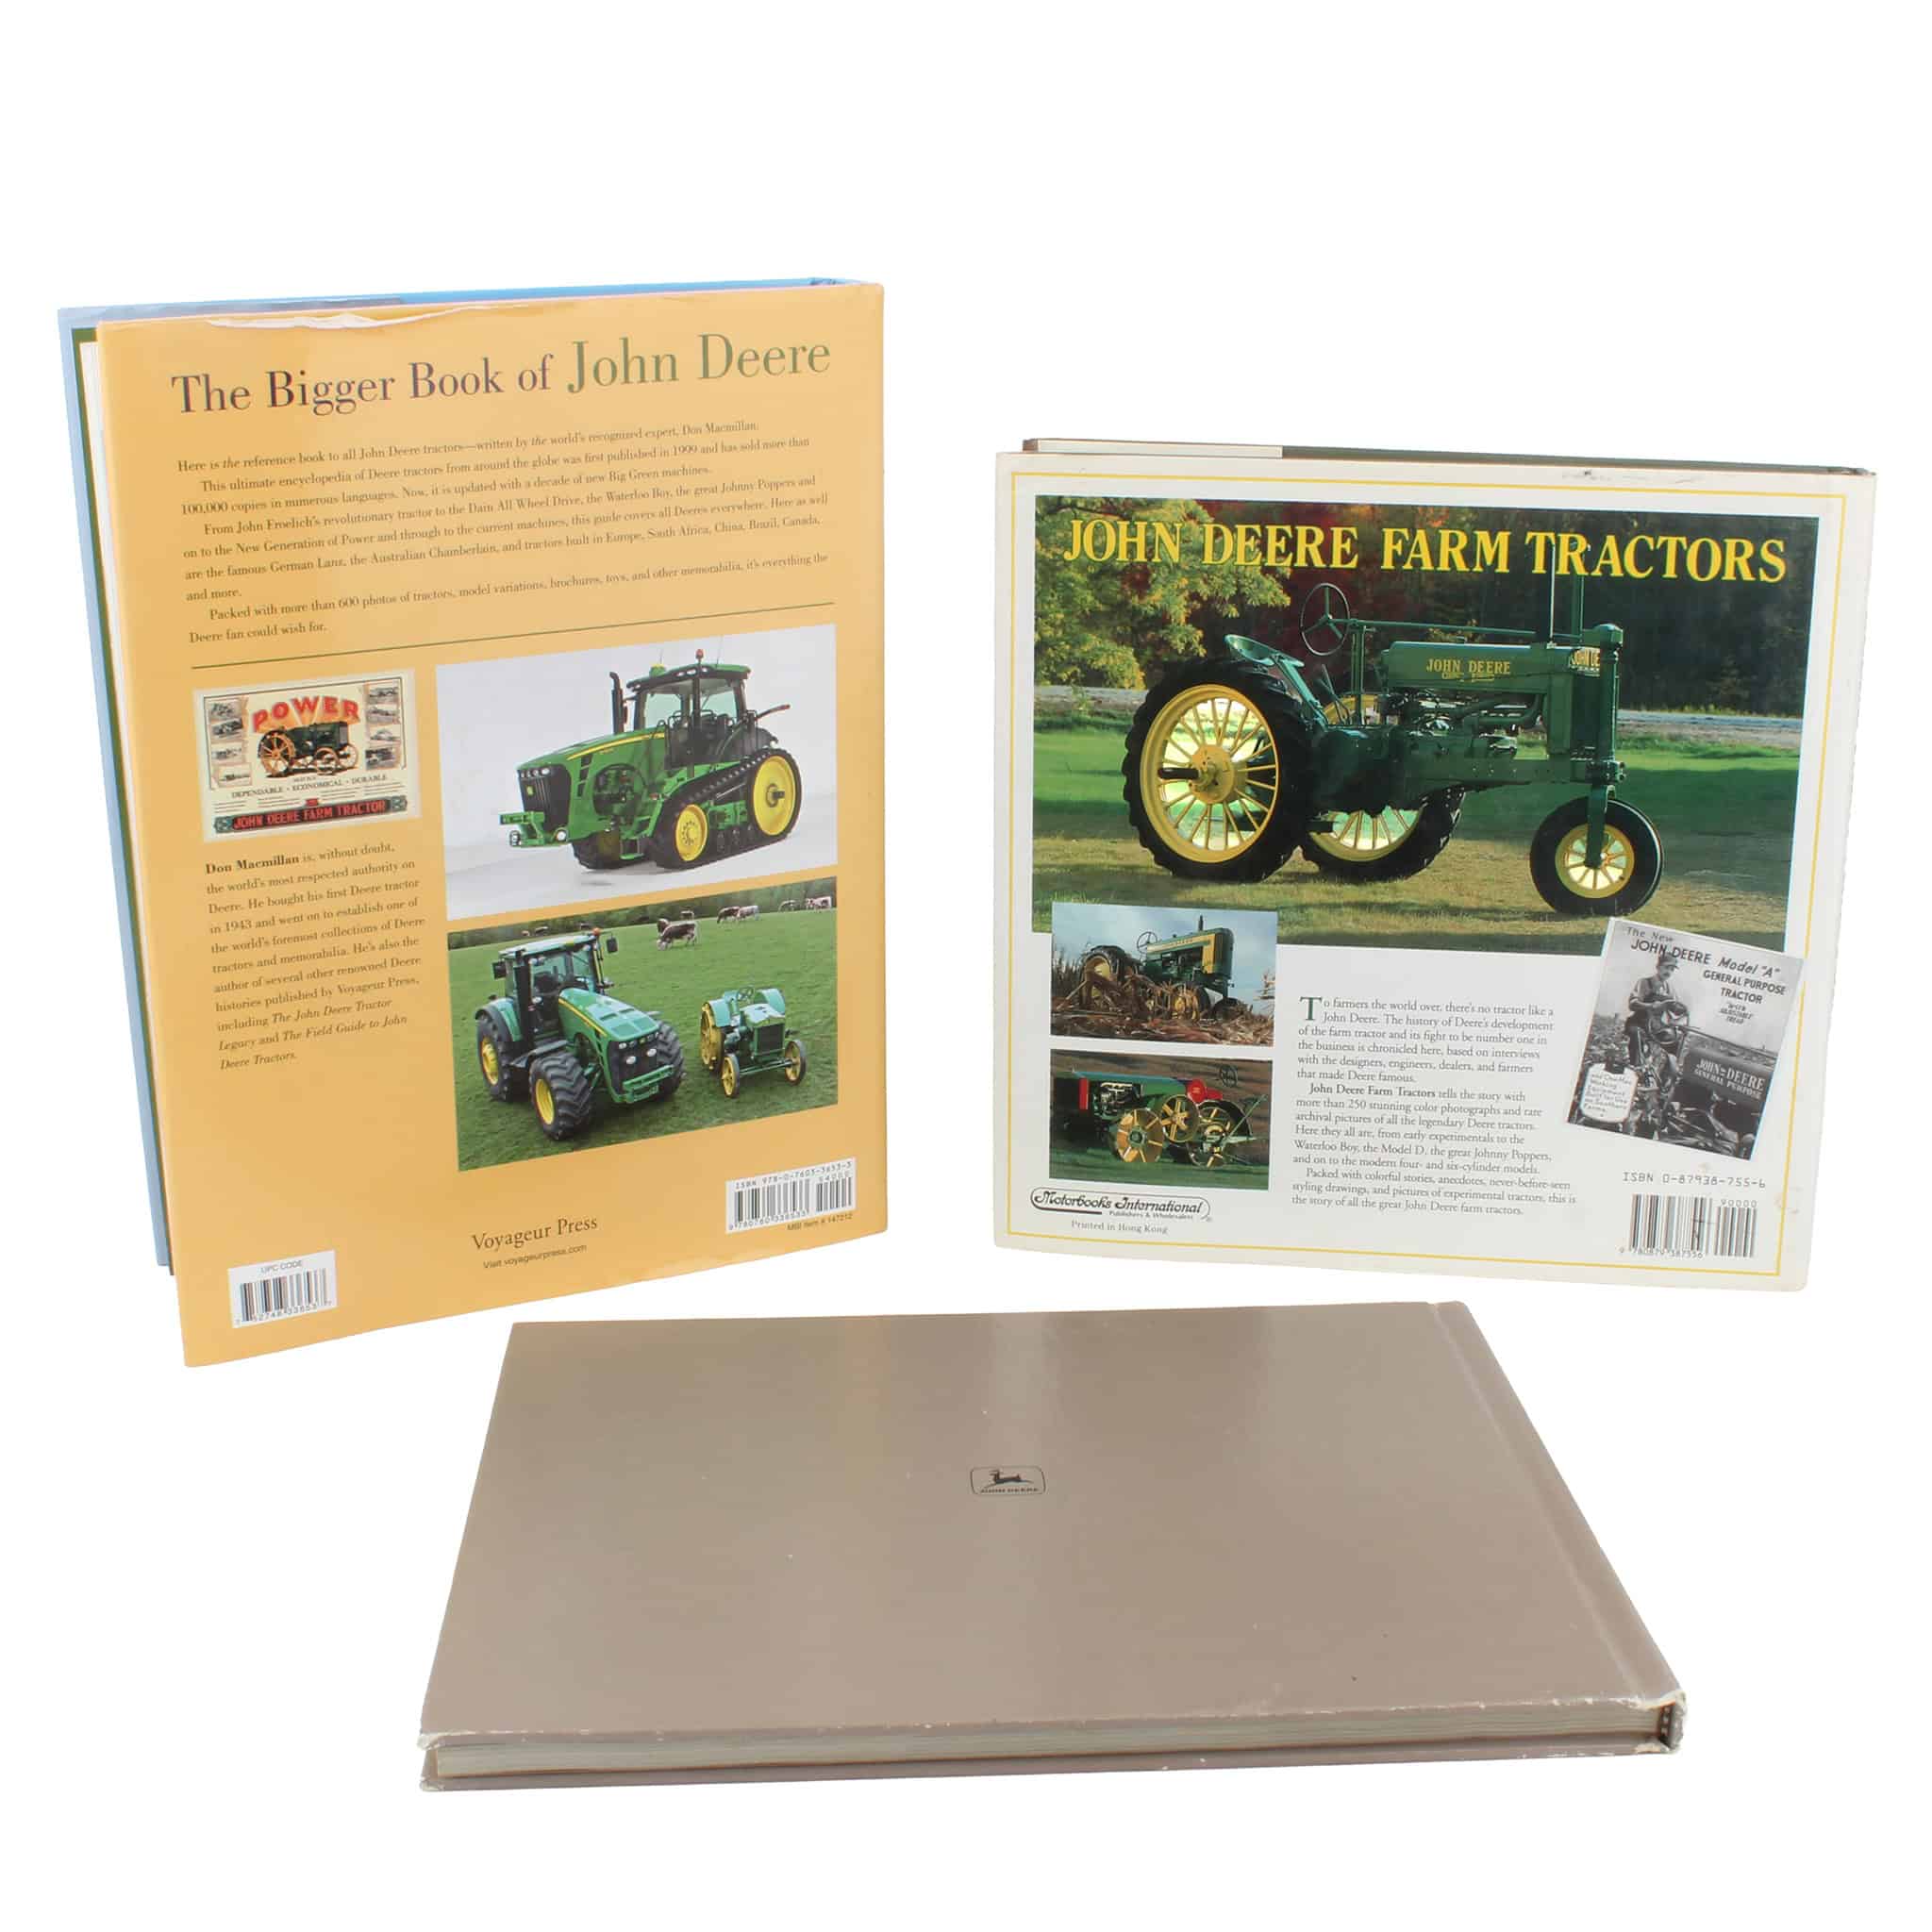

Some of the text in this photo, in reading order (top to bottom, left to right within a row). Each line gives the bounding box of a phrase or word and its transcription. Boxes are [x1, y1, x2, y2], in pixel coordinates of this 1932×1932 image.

[172, 332, 831, 416] The Bigger Book of John Deere
[177, 460, 206, 472] Here
[209, 459, 219, 470] is
[222, 458, 240, 469] the
[242, 454, 295, 467] reference
[298, 452, 325, 463] book
[325, 451, 339, 461] to
[341, 450, 357, 460] all
[358, 448, 388, 461] John
[388, 445, 421, 457] Deere
[515, 438, 527, 451] by
[530, 437, 547, 447] the
[550, 434, 585, 445] world's
[681, 425, 702, 437] Don
[1062, 519, 1788, 584] JOHN DEERE FARM TRACTORS
[186, 591, 208, 601] and
[190, 631, 223, 643] Deere
[225, 629, 244, 640] fan
[246, 626, 277, 639] could
[280, 625, 306, 636] wish
[1426, 658, 1511, 675] JOHN DEERE
[253, 695, 360, 733] POWER
[231, 788, 283, 798] DEPENDABLE
[352, 774, 388, 784] DURABLE
[233, 800, 386, 829] JOHN DEERE FARM TRACTOR
[206, 861, 232, 874] Don
[236, 853, 299, 871] Macmillan
[319, 846, 358, 860] without
[247, 897, 264, 909] He
[266, 892, 304, 909] bought
[306, 890, 324, 902] his
[325, 887, 346, 900] first
[349, 883, 382, 897] Deere
[384, 878, 419, 892] tractor
[1626, 926, 1675, 942] The New
[1631, 940, 1667, 956] JOHN
[1674, 946, 1711, 965] DEERE
[1718, 957, 1759, 976] Model
[1703, 970, 1786, 996] GENERAL PURPOSE
[1720, 987, 1763, 1004] TRACTOR
[218, 997, 391, 1034] including The John Deere Tractor
[1300, 996, 1330, 1021] To
[1332, 999, 1369, 1009] farmers
[1371, 1000, 1387, 1009] the
[1390, 1001, 1417, 1010] world
[1445, 1003, 1474, 1012] there's
[1493, 1004, 1524, 1014] tractor
[1527, 1005, 1545, 1015] like
[219, 1015, 407, 1052] Legacy and The Field Guide to John
[1323, 1013, 1348, 1025] John
[1383, 1015, 1403, 1025] The
[1405, 1016, 1440, 1029] history
[1441, 1018, 1454, 1027] of
[1455, 1018, 1489, 1028] Deere's
[1491, 1020, 1552, 1033] development
[220, 1056, 249, 1070] Deere
[1297, 1069, 1316, 1078] that
[1318, 1070, 1344, 1080] made
[1347, 1071, 1376, 1081] Deere
[1727, 1067, 1765, 1091] DEERE
[1309, 1084, 1524, 1103] John Deere Farm Tractors tells the story with
[736, 1180, 757, 1190] ISBN
[1623, 1172, 1766, 1189] ISBN 0-87938-755-6
[1035, 1191, 1203, 1214] Motorbooks International
[1291, 1194, 1307, 1205] the
[1309, 1195, 1333, 1208] story
[1335, 1196, 1346, 1207] of
[1347, 1197, 1358, 1207] all
[1361, 1198, 1376, 1208] the
[1378, 1198, 1401, 1211] great
[1405, 1200, 1426, 1212] John
[1430, 1201, 1458, 1211] Deere
[1460, 1202, 1483, 1212] farm
[1721, 1199, 1757, 1208] 90000
[472, 1217, 597, 1252] Voyageur Press
[1071, 1219, 1105, 1231] Printed
[1119, 1223, 1141, 1233] Hong
[1144, 1224, 1168, 1234] Kong
[280, 1260, 302, 1270] CODE
[483, 1244, 587, 1269] Visit voyageurpress.com
